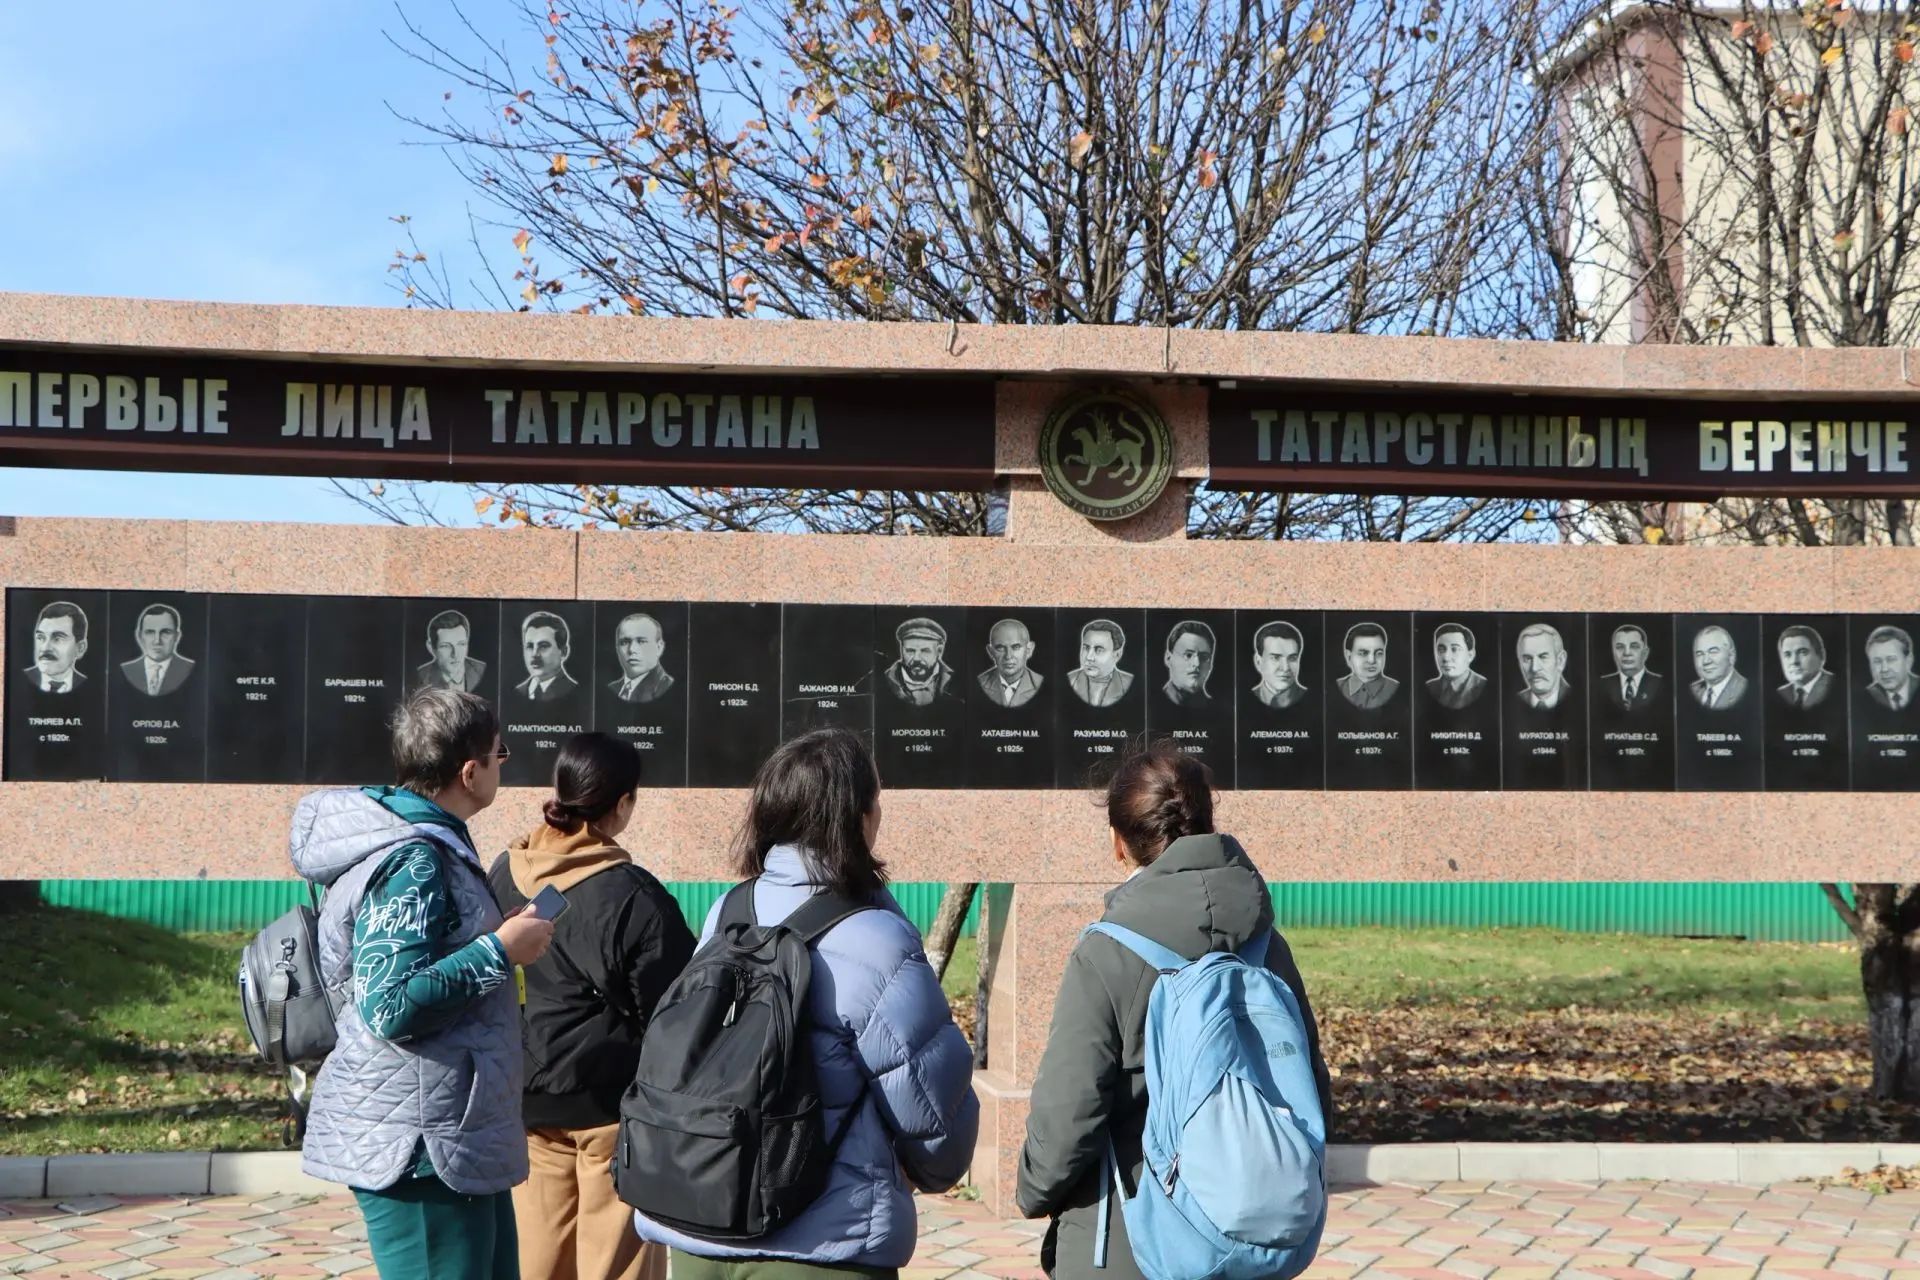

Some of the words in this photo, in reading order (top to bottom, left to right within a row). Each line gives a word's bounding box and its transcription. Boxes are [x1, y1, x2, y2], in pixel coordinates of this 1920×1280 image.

[0, 371, 229, 434] ПЕРВЫЕ
[281, 382, 432, 448] ЛИЦА
[484, 389, 820, 449] ТАТАРСТАНА
[1250, 408, 1649, 477] ТАТАРСТАННЫҢ
[1699, 420, 1909, 473] БЕРЕНЧЕ
